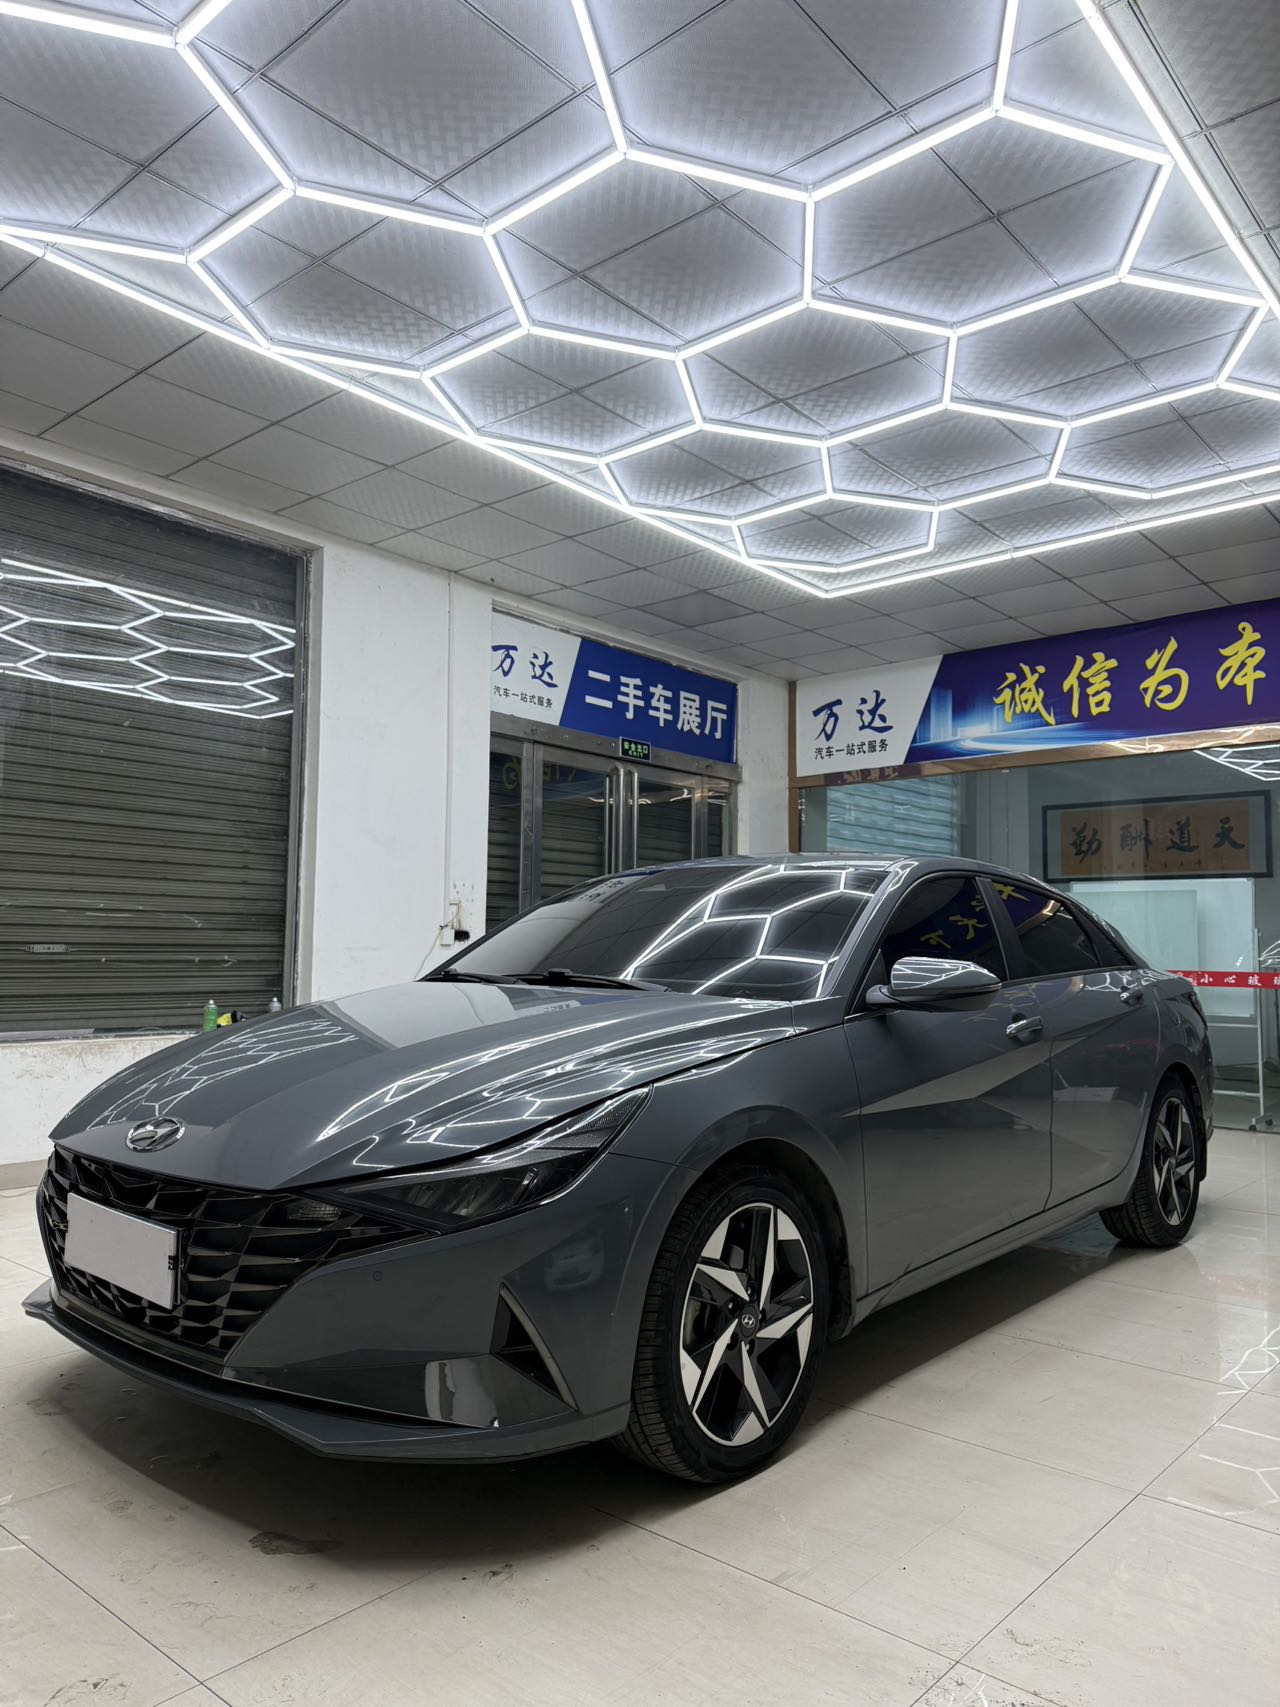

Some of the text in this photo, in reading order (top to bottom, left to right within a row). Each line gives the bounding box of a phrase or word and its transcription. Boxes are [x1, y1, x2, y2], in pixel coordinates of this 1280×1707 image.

[491, 644, 559, 688] 万达
[993, 621, 1266, 727] 诚信为本
[493, 685, 553, 709] 汽车一站式服务
[584, 669, 728, 740] 二手车展厅
[812, 689, 894, 742] 万达
[814, 738, 889, 761] 汽车一站式服务
